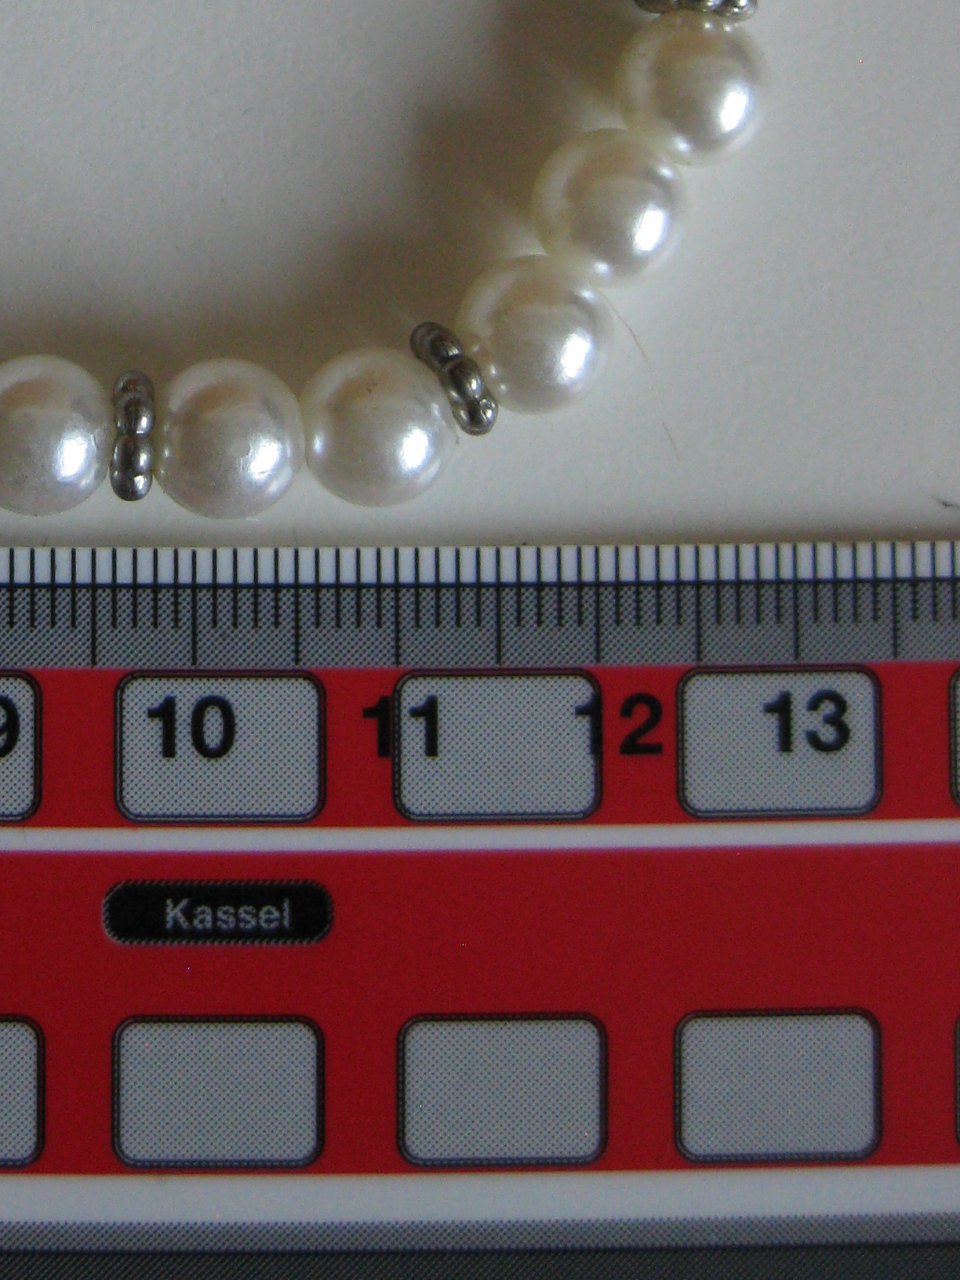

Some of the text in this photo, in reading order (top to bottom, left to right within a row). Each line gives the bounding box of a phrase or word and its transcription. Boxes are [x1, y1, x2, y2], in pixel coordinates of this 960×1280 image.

[147, 695, 236, 759] 10
[362, 695, 439, 757] 11
[576, 692, 664, 756] 12
[763, 690, 851, 753] 13
[165, 898, 291, 933] Kassel
